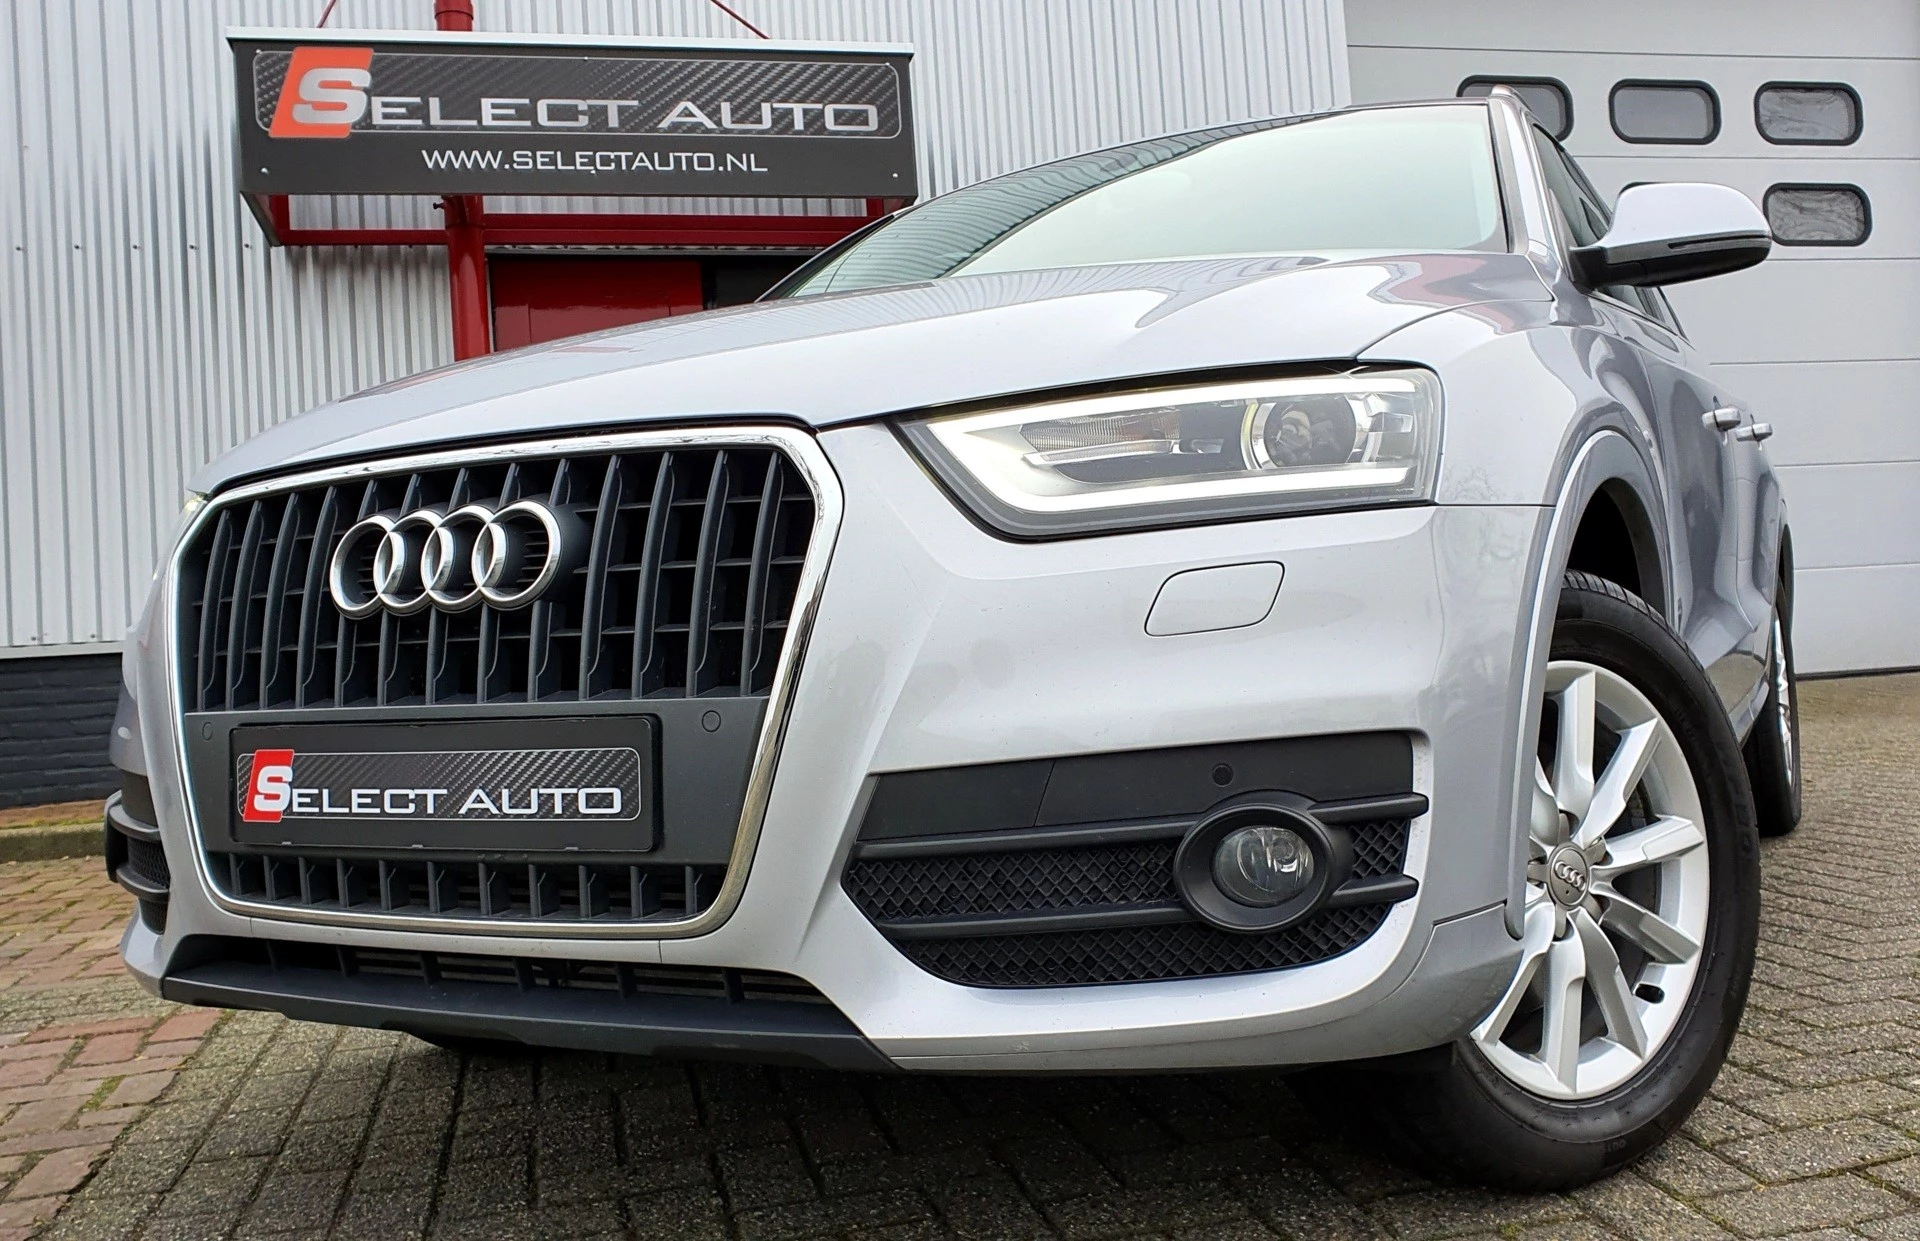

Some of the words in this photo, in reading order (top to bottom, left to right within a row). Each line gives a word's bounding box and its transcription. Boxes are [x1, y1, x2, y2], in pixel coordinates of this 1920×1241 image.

[292, 67, 638, 128] SELECT
[657, 99, 878, 132] AUTO
[422, 149, 768, 173] WWW.SELECTAUTO.NL
[254, 766, 447, 814] SELECT
[458, 787, 622, 816] AUTO
